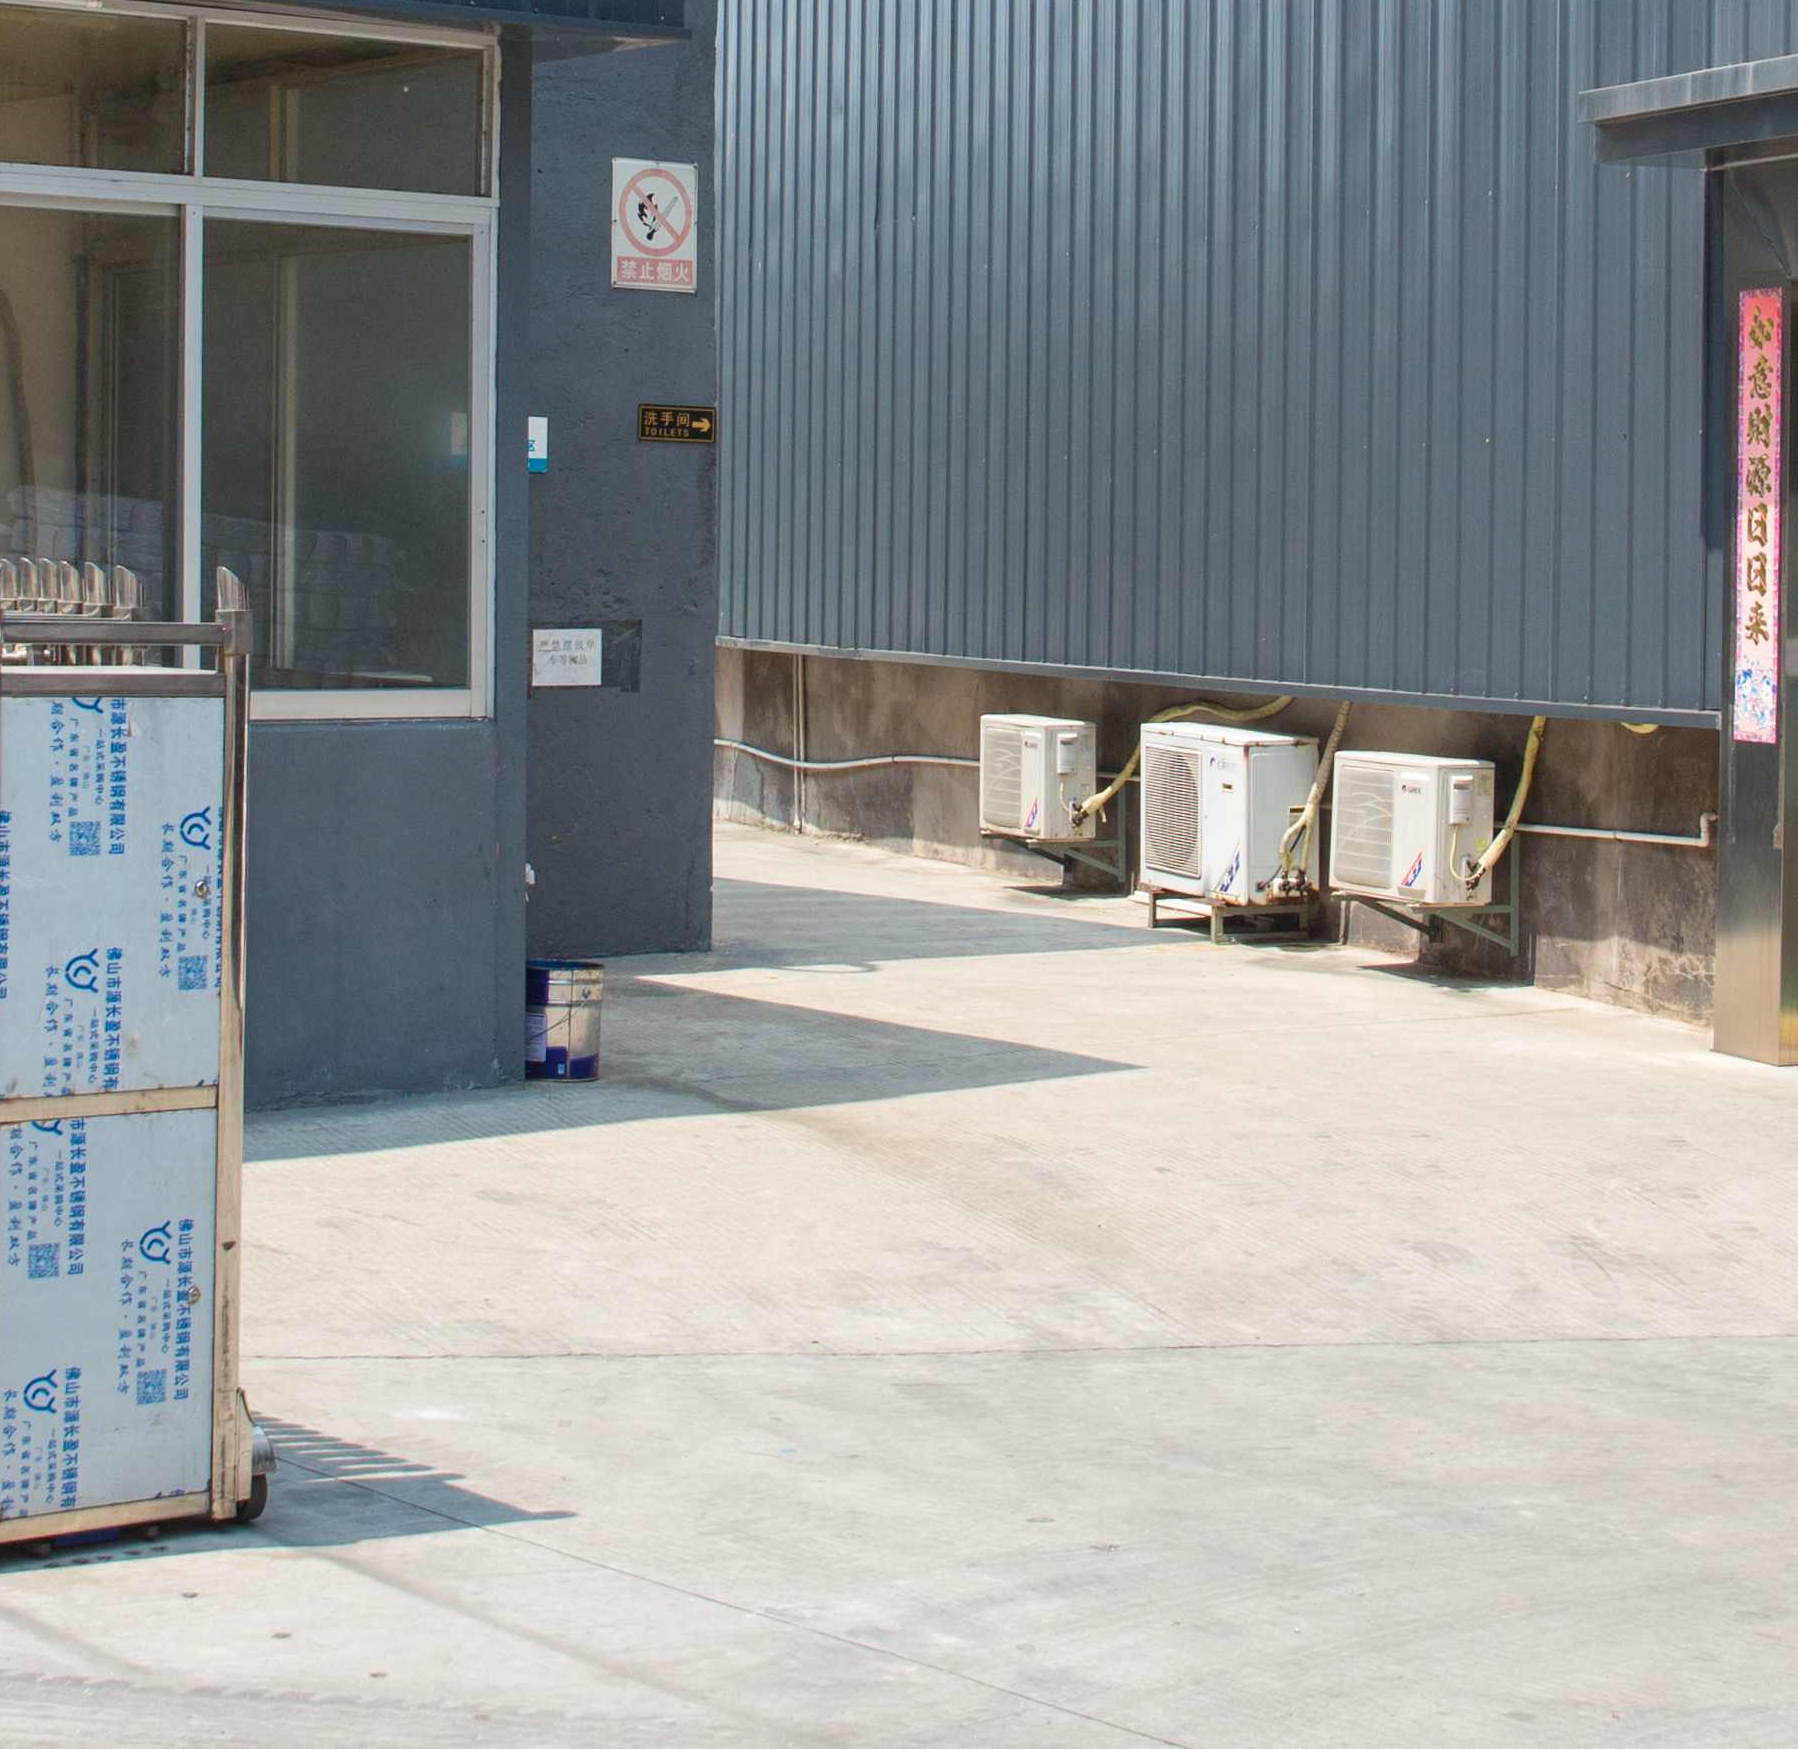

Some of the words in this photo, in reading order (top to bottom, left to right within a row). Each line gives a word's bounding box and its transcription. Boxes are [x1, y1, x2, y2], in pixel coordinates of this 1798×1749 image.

[621, 260, 691, 282] 禁止烟火
[644, 411, 691, 426] 洗手间
[645, 428, 690, 437] TOILETS
